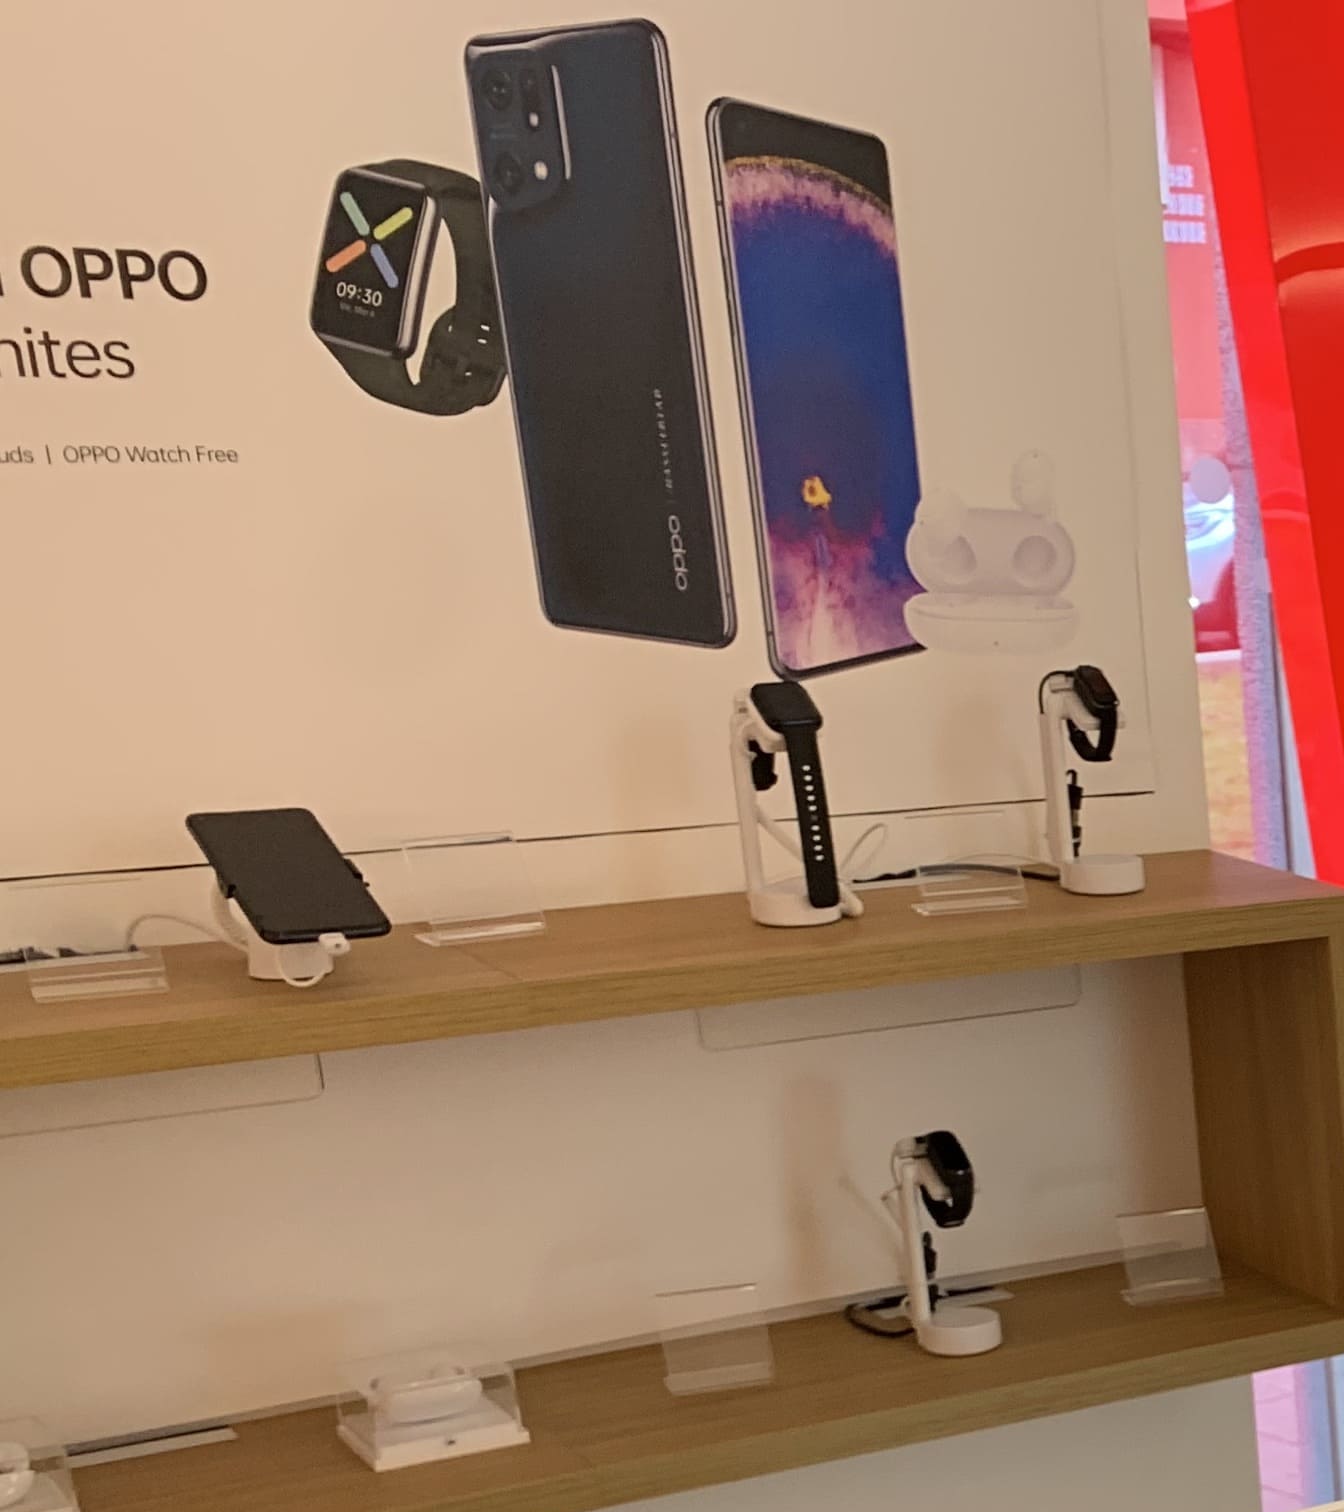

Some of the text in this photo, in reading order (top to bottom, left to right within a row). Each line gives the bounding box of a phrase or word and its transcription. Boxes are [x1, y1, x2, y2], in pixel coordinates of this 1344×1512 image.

[20, 245, 208, 301] OPPO
[336, 281, 383, 307] 09:30
[62, 445, 120, 464] OPPO
[125, 446, 191, 464] Watch
[195, 445, 239, 464] Free
